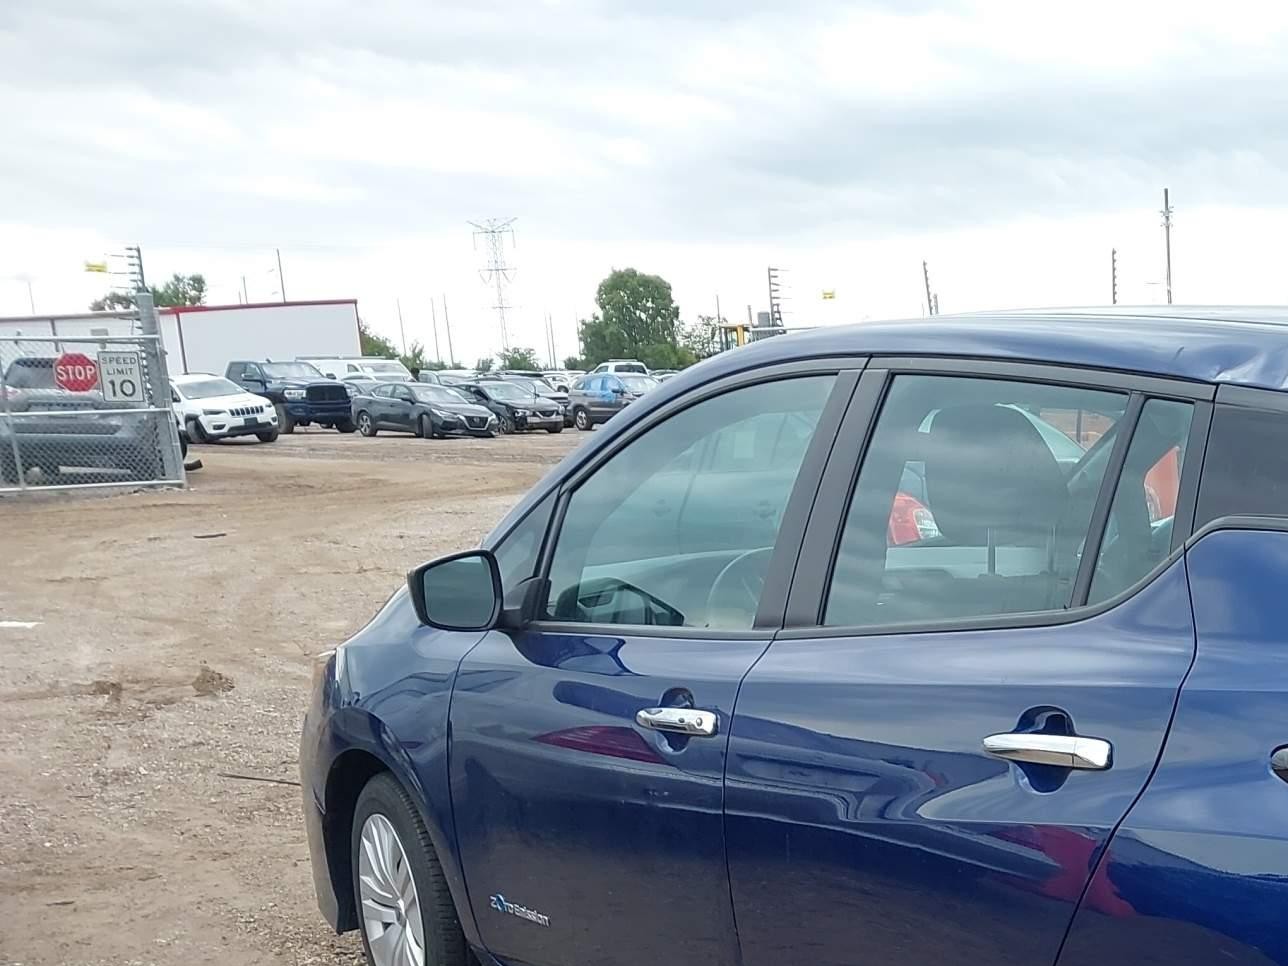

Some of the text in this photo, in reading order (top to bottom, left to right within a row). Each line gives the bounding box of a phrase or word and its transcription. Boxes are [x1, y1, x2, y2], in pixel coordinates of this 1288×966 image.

[101, 356, 137, 365] SPEED
[56, 365, 95, 381] STOP
[106, 367, 134, 375] LIMIT
[108, 379, 136, 397] 10
